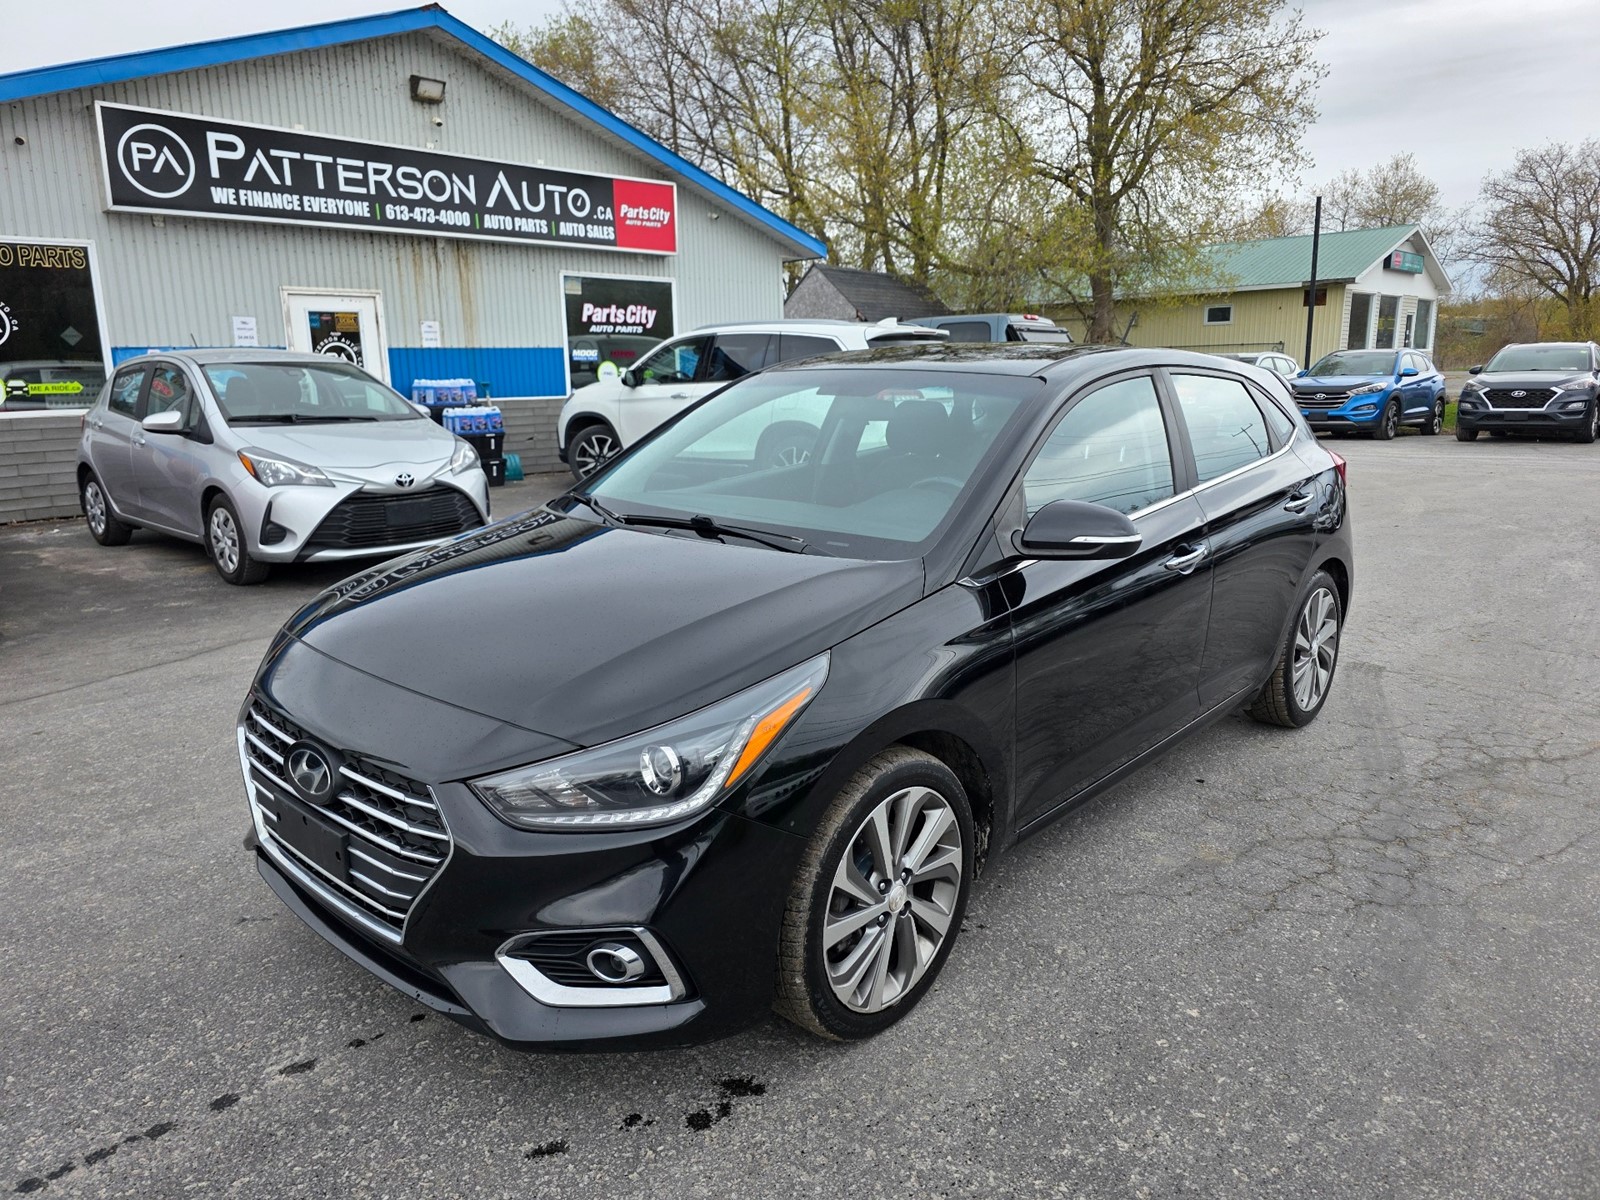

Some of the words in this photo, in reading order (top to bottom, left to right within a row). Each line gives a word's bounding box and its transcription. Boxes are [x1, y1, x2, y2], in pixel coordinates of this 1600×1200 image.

[205, 130, 477, 206] PATTERSON
[210, 186, 239, 206] WE
[239, 189, 302, 211] FINANCE
[303, 195, 371, 218] EVERYONE
[385, 204, 471, 227] 613-473-4000
[484, 213, 513, 231] AUTO
[514, 217, 548, 234] PARTS
[625, 219, 643, 227] AUTO
[643, 220, 662, 228] PARTS
[559, 221, 587, 238] AUTO
[587, 224, 615, 241] SALES
[17, 244, 86, 269] PARTS
[581, 302, 657, 329] PartsCity
[589, 325, 613, 334] AUTO
[615, 325, 643, 334] PARTS
[572, 349, 598, 357] MOOG
